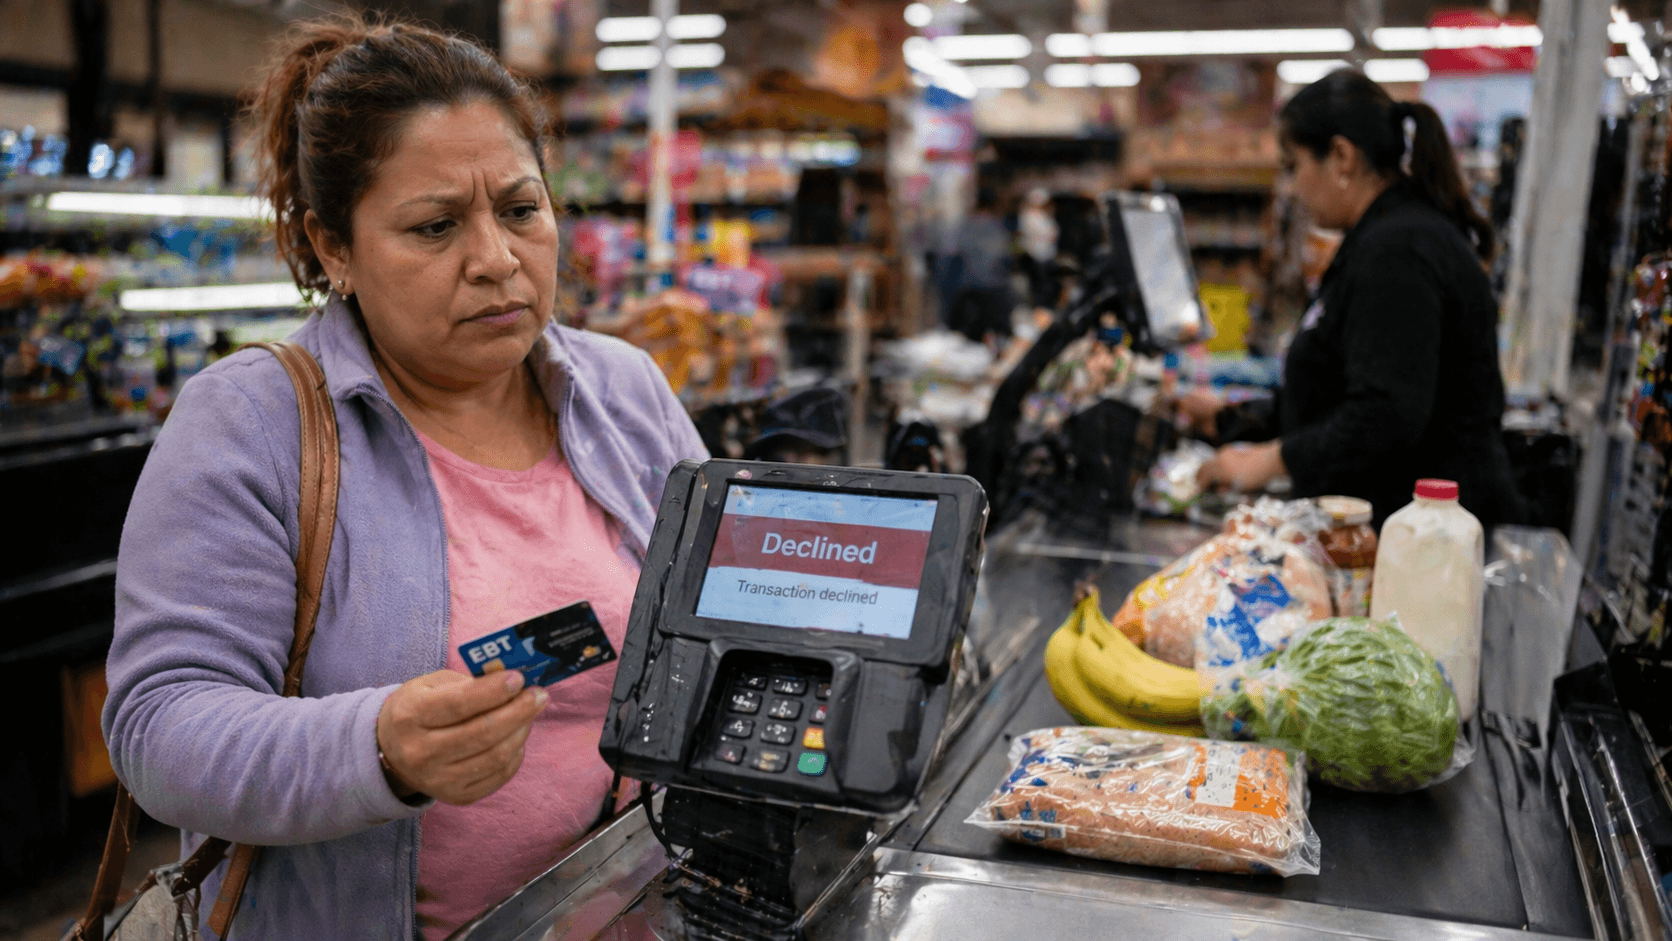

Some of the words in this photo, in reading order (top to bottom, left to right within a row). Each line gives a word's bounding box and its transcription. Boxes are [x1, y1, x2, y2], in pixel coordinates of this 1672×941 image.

[761, 532, 878, 565] Declined
[737, 579, 816, 600] Transaction
[819, 587, 879, 605] declined
[468, 635, 513, 664] EBT
